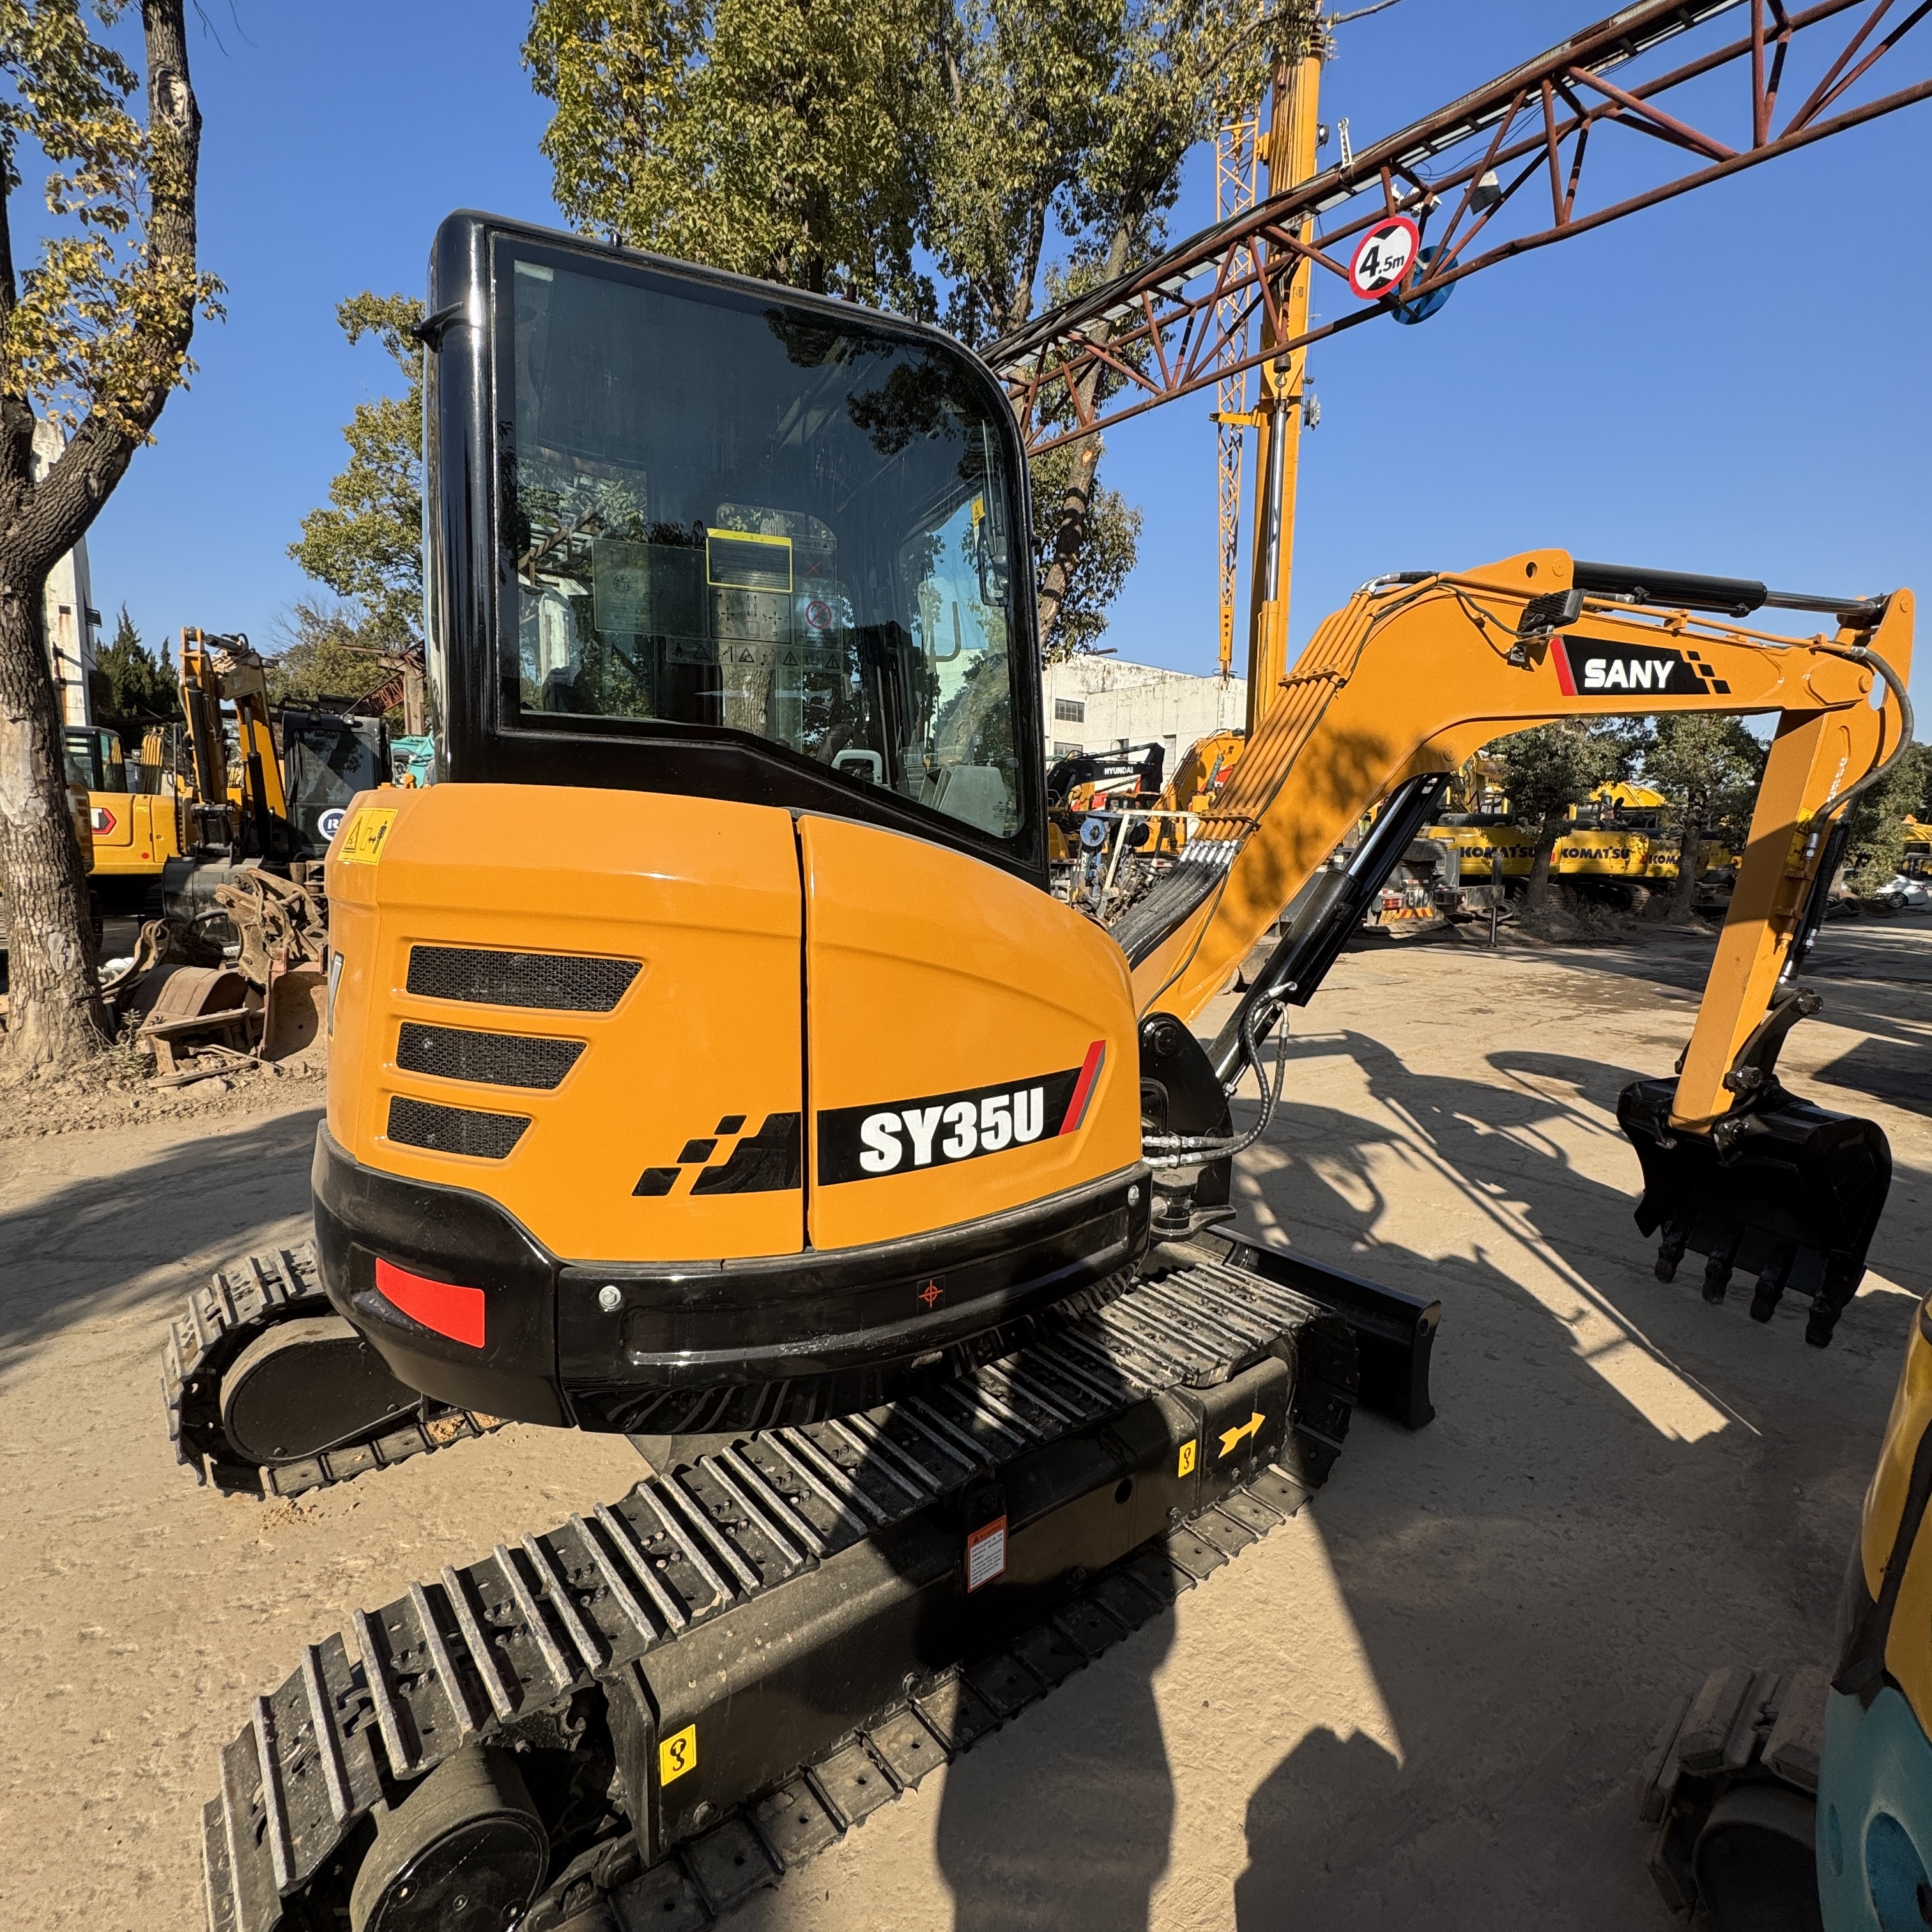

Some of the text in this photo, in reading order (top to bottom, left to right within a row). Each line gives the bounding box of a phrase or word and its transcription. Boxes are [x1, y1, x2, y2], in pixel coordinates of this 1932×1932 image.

[1358, 244, 1405, 279] 4.5m
[1584, 658, 1675, 689] SANY
[1104, 766, 1134, 776] HYUNDAI
[1460, 843, 1536, 859] KOMATSU
[1561, 846, 1631, 860] KOMATSU
[859, 1085, 1044, 1173] SY35U
